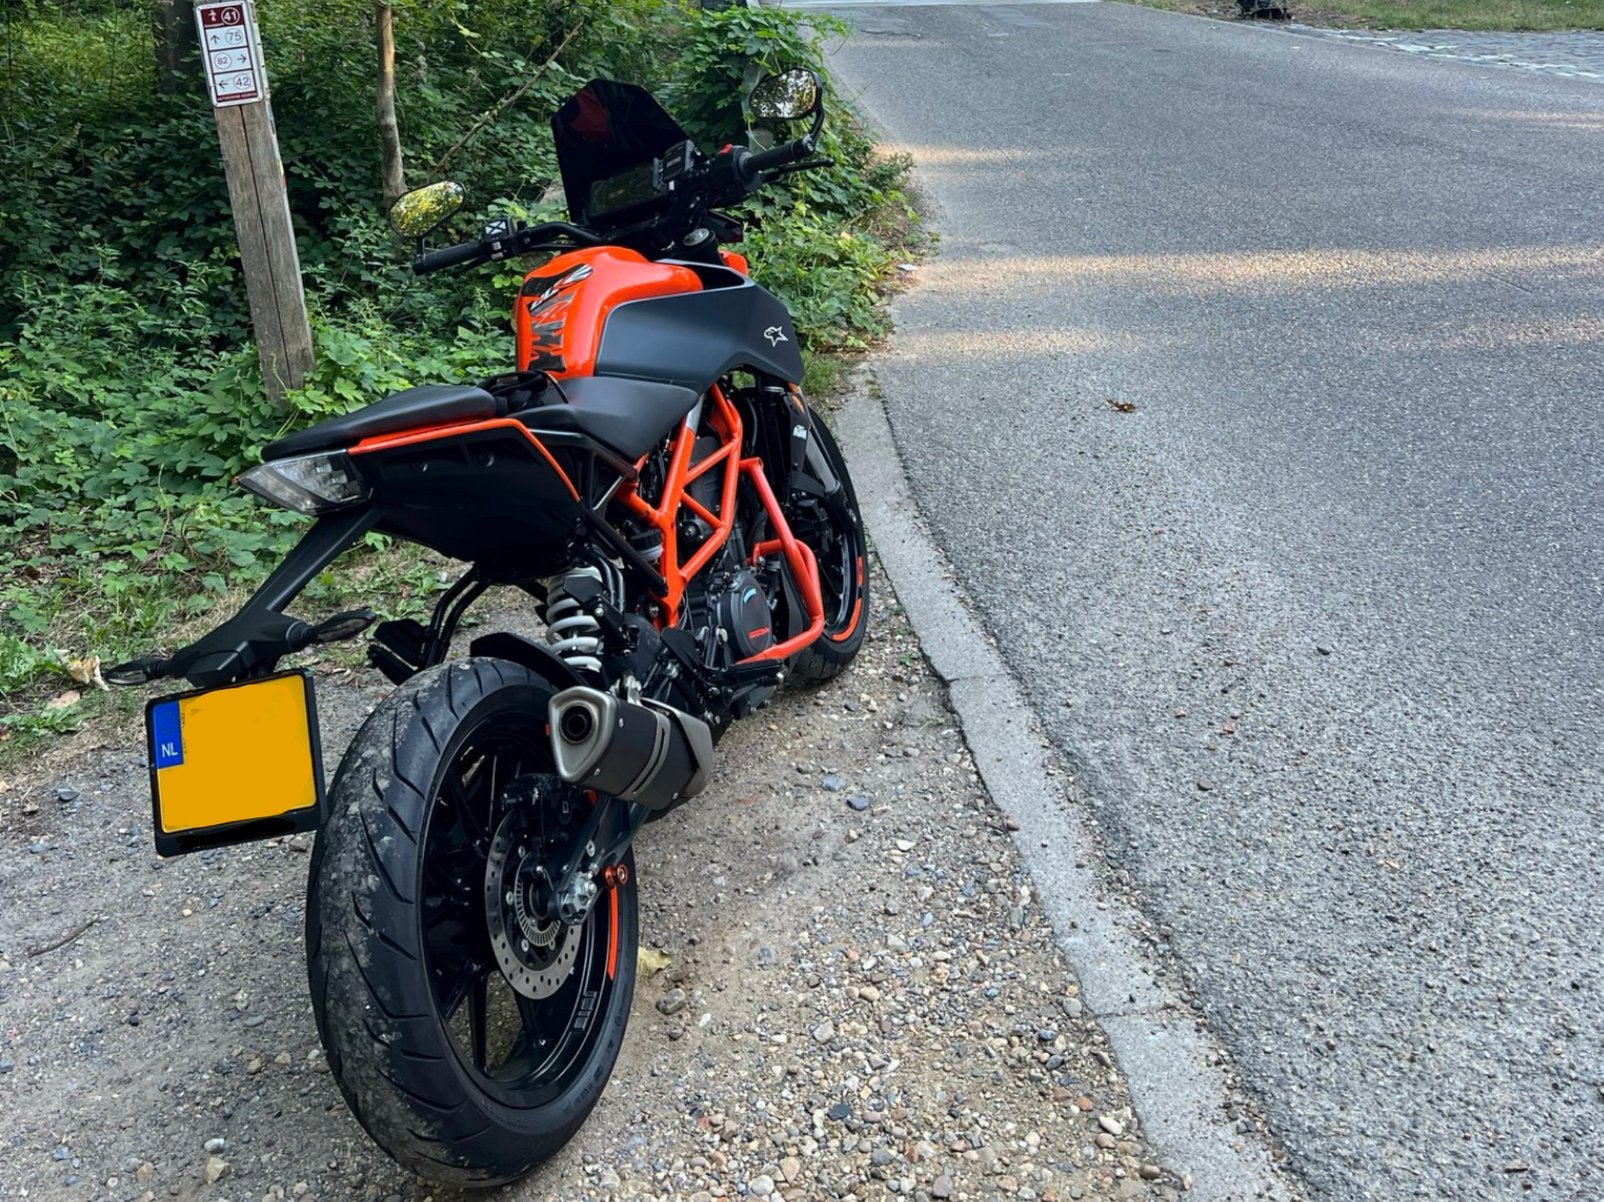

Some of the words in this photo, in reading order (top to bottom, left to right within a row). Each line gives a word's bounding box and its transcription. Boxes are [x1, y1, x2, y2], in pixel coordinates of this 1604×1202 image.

[224, 11, 237, 21] 41
[227, 32, 242, 41] 75
[217, 57, 228, 65] 82
[236, 77, 250, 87] 42
[161, 742, 178, 758] NL
